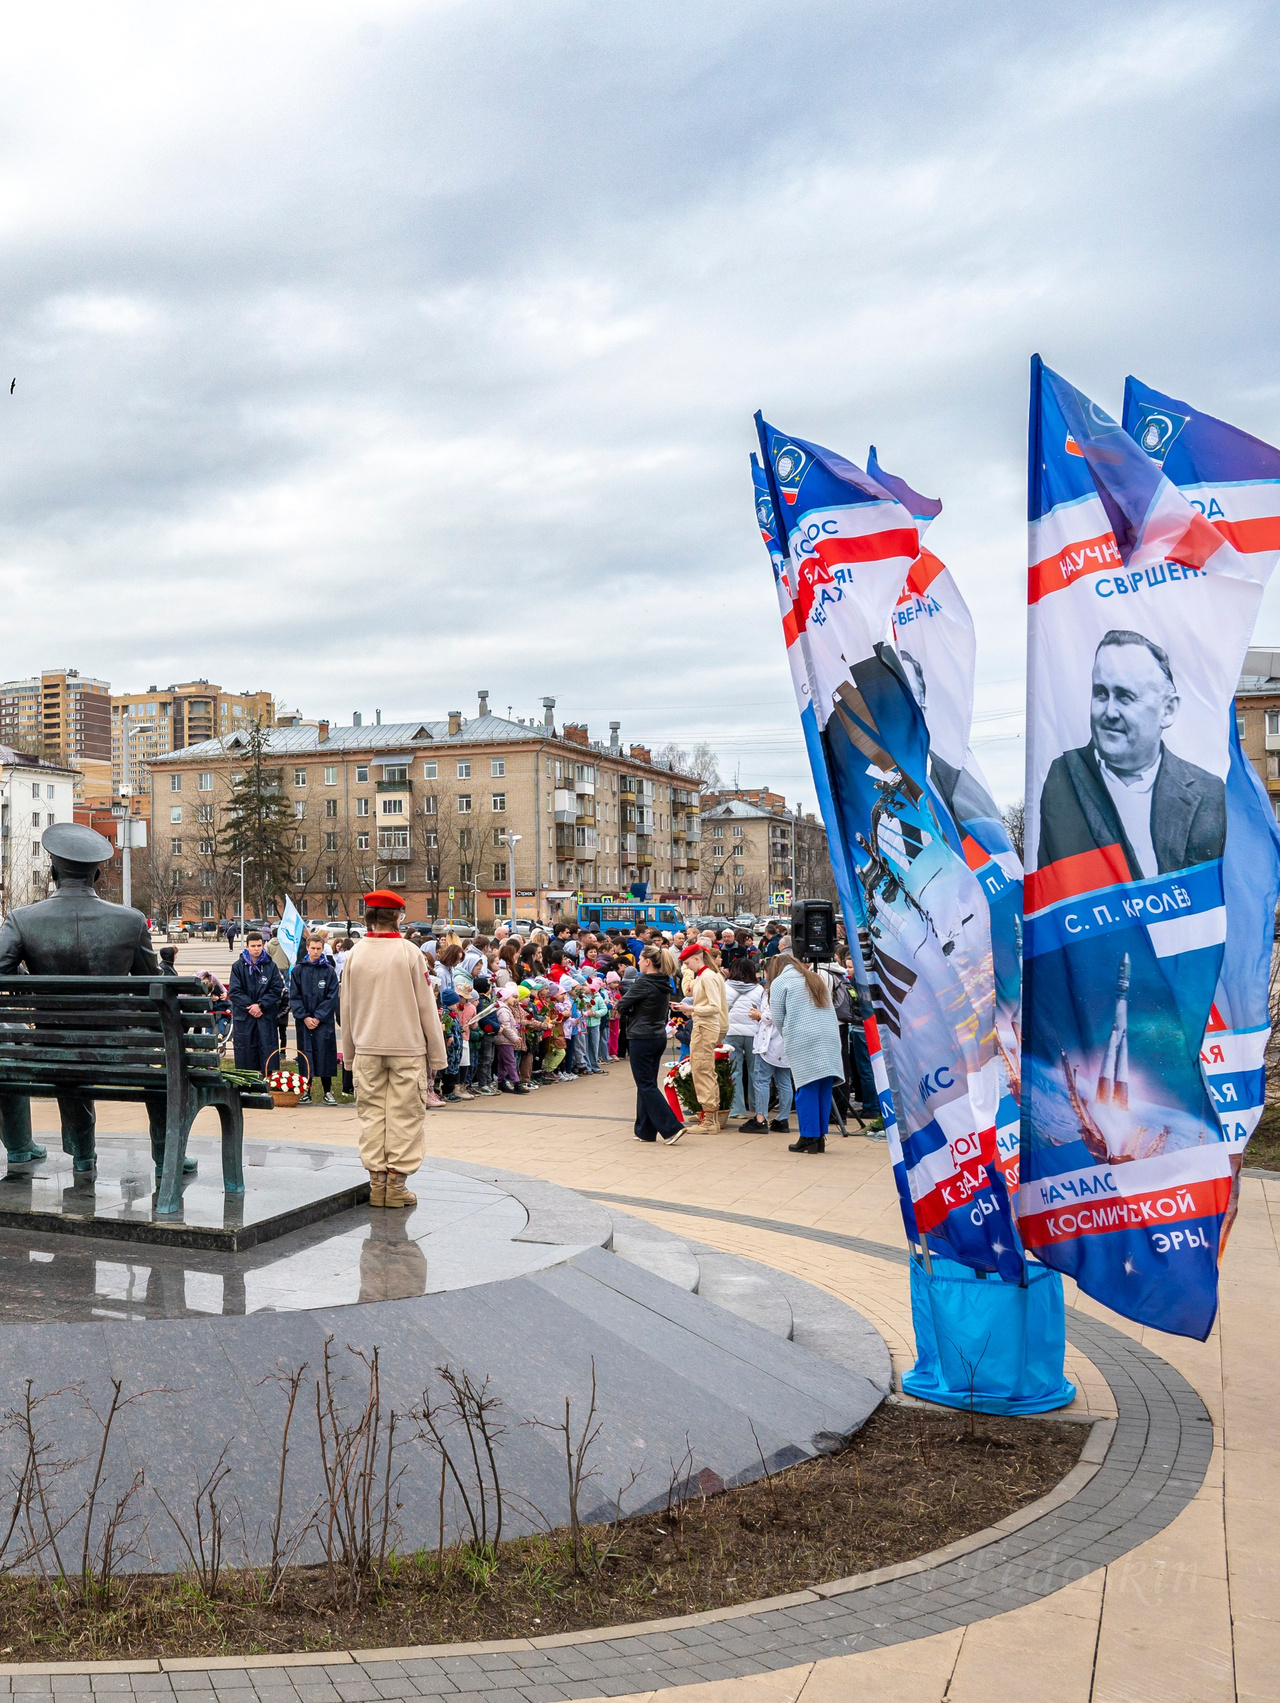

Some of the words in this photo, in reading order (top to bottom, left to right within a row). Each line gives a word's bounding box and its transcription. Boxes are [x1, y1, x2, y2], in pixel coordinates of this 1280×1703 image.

[1059, 540, 1122, 580] НАУЧН
[1064, 914, 1090, 934] С.
[1093, 905, 1120, 926] П.
[940, 1186, 956, 1205] К
[1151, 1226, 1207, 1253] ЭРЫ
